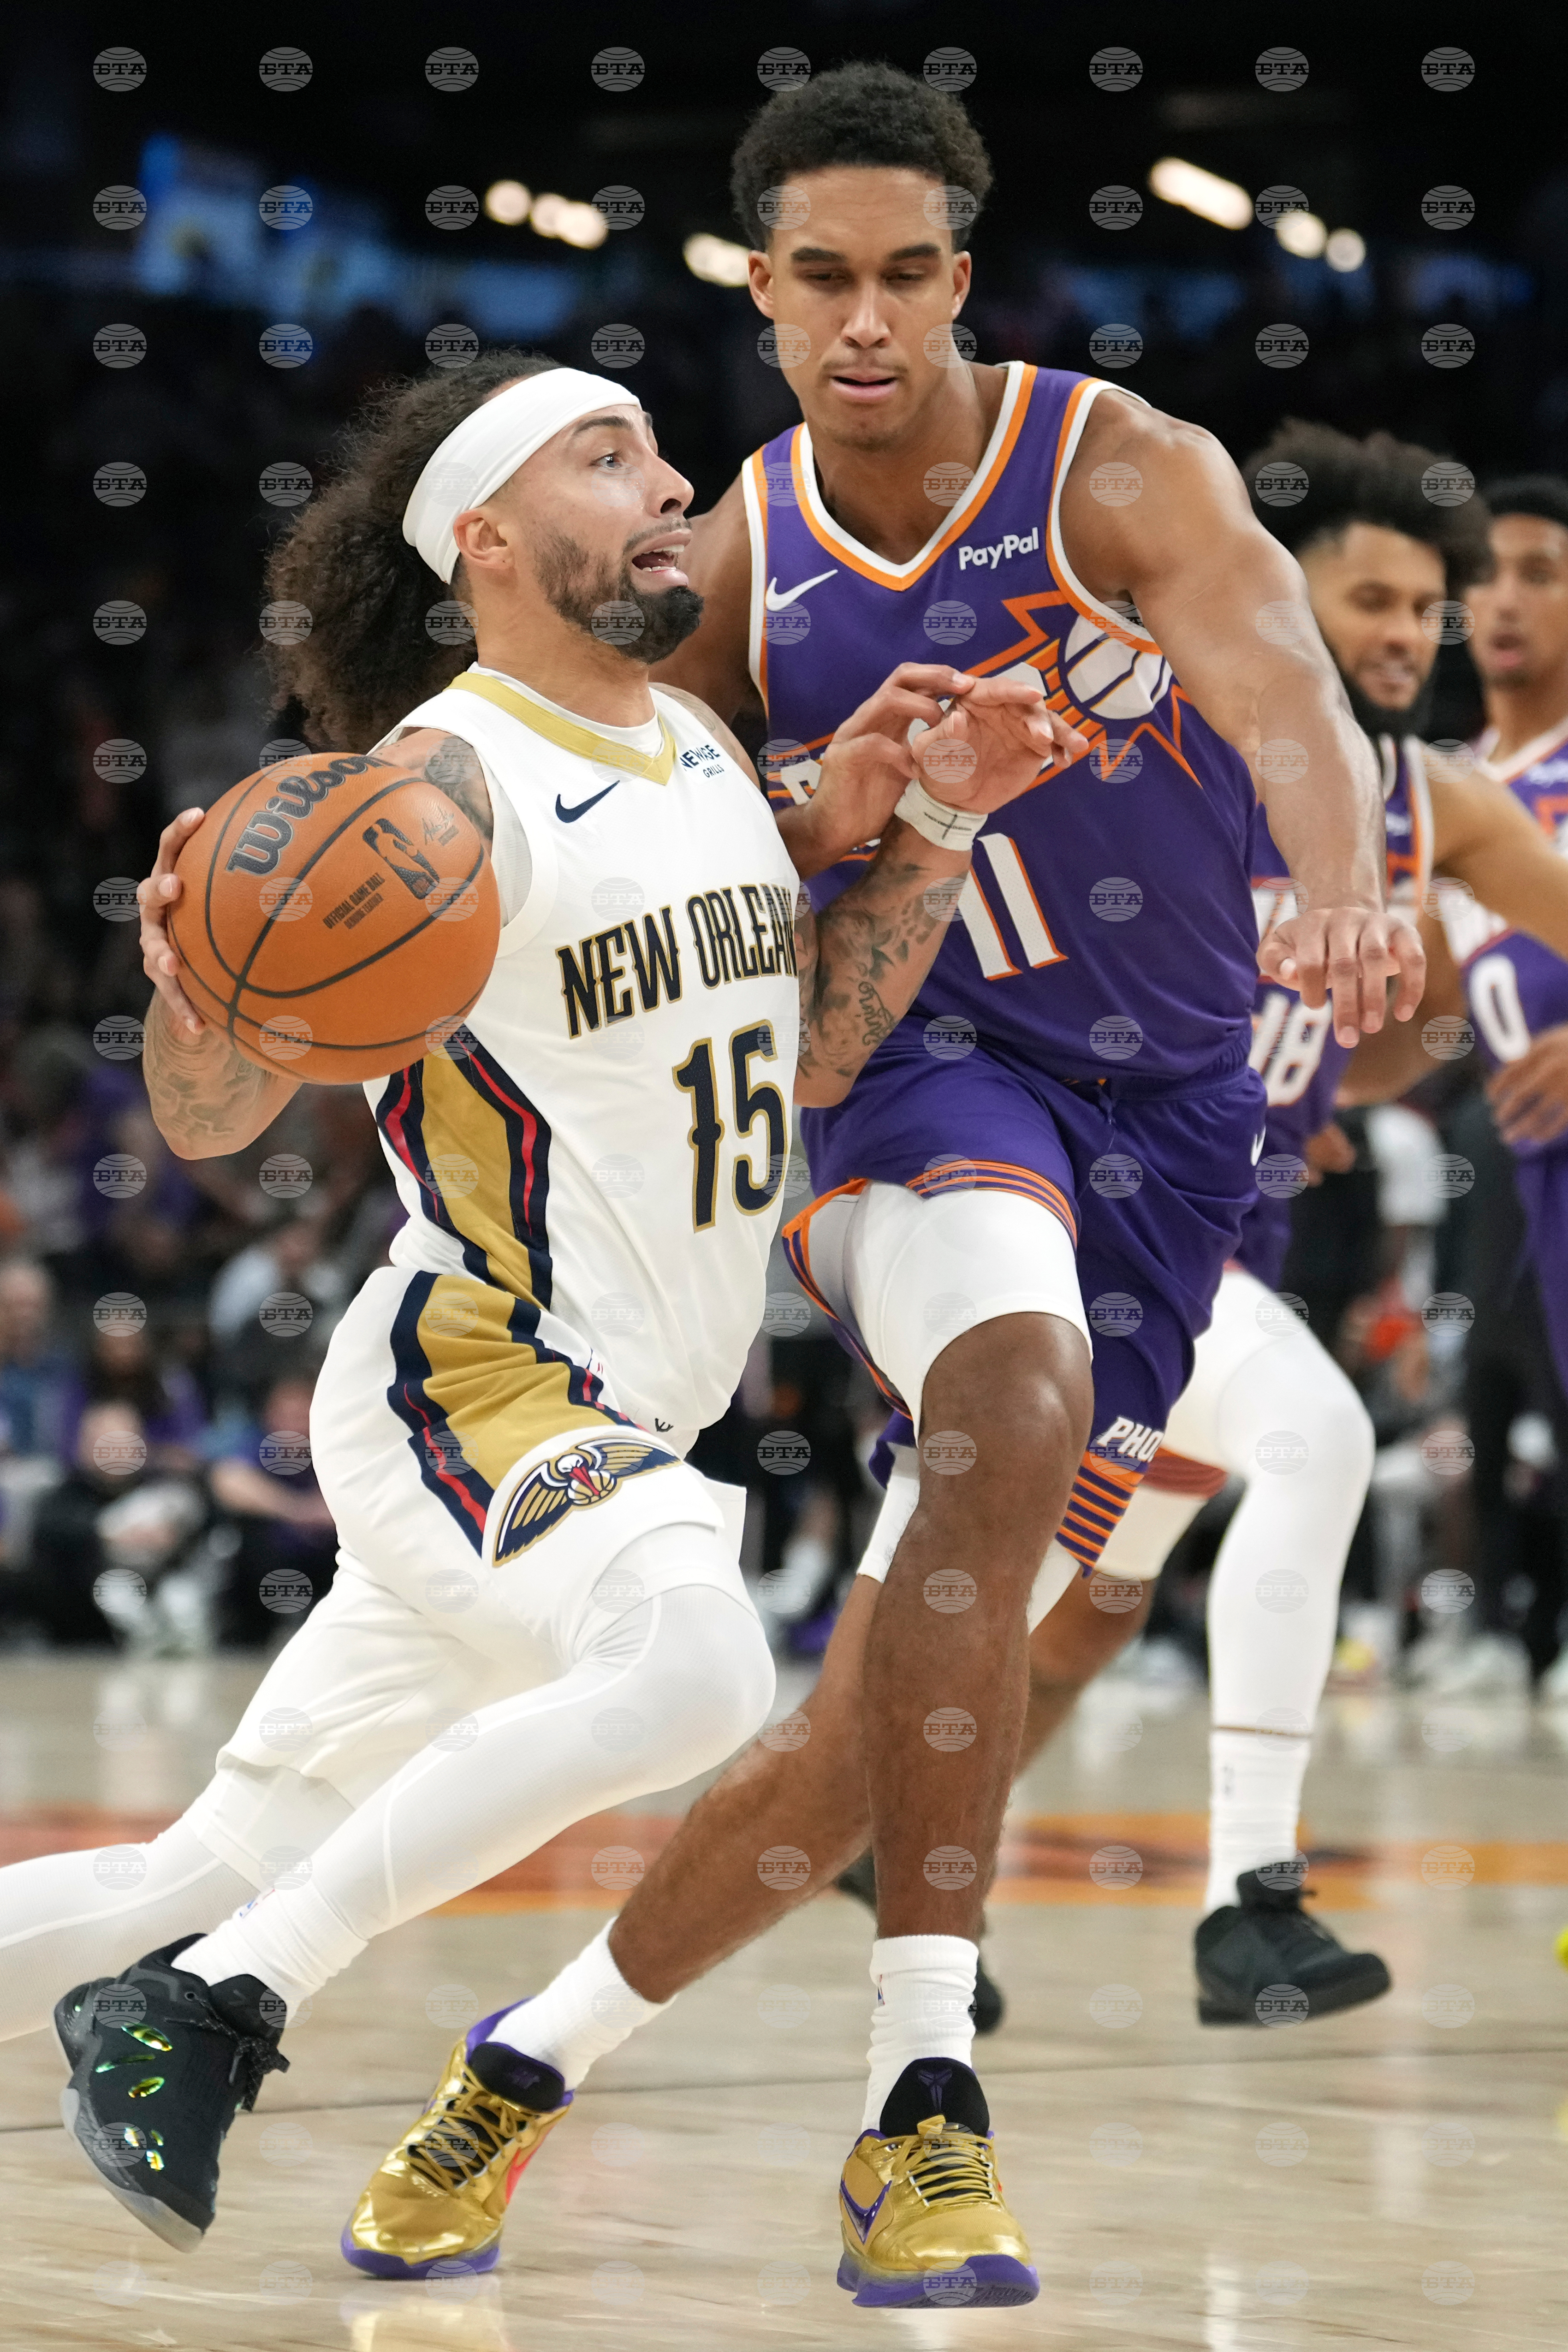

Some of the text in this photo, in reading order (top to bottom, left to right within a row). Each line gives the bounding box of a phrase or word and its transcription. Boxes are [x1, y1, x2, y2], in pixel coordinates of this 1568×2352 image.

[959, 527, 1039, 570] PayPal
[226, 756, 397, 875] Wilson
[702, 764, 725, 778] GRILLS
[958, 832, 1069, 981] 11
[555, 904, 683, 1039] NEW
[671, 1019, 788, 1234] 15
[1097, 1416, 1165, 1463] PHO
